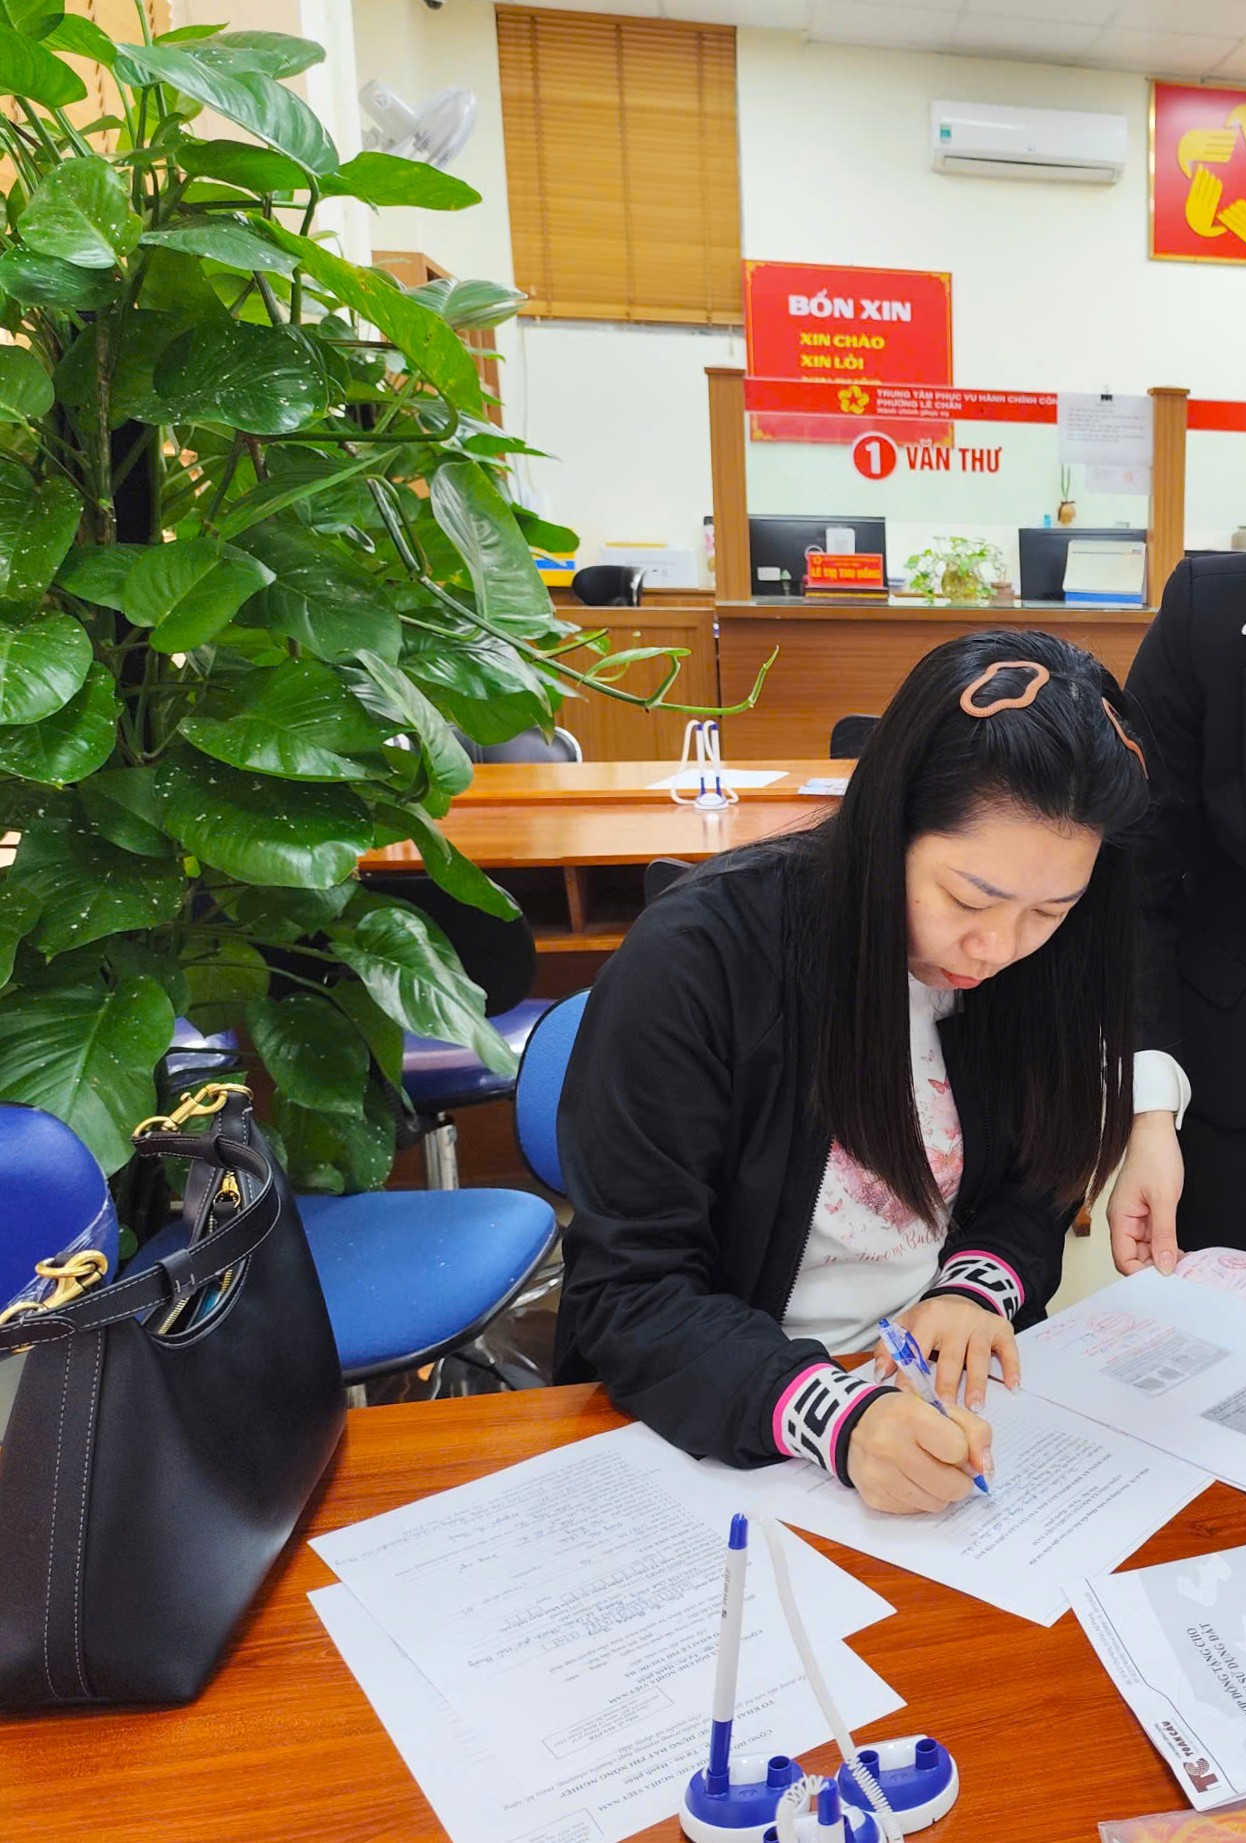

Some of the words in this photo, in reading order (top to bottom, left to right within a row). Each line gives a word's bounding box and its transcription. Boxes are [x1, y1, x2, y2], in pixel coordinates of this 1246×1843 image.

[788, 288, 854, 319] BỐN
[860, 299, 912, 322] XIN
[800, 332, 830, 347] XIN
[833, 330, 885, 349] CHÀO
[801, 354, 831, 368] XIN
[877, 389, 911, 399] TRUNG
[913, 388, 934, 400] TÂM
[979, 392, 1006, 403] HÀNH
[1007, 393, 1037, 405] CHÍNH
[865, 441, 881, 475] 1
[906, 438, 951, 471] VĂN
[959, 446, 1003, 473] THƯ
